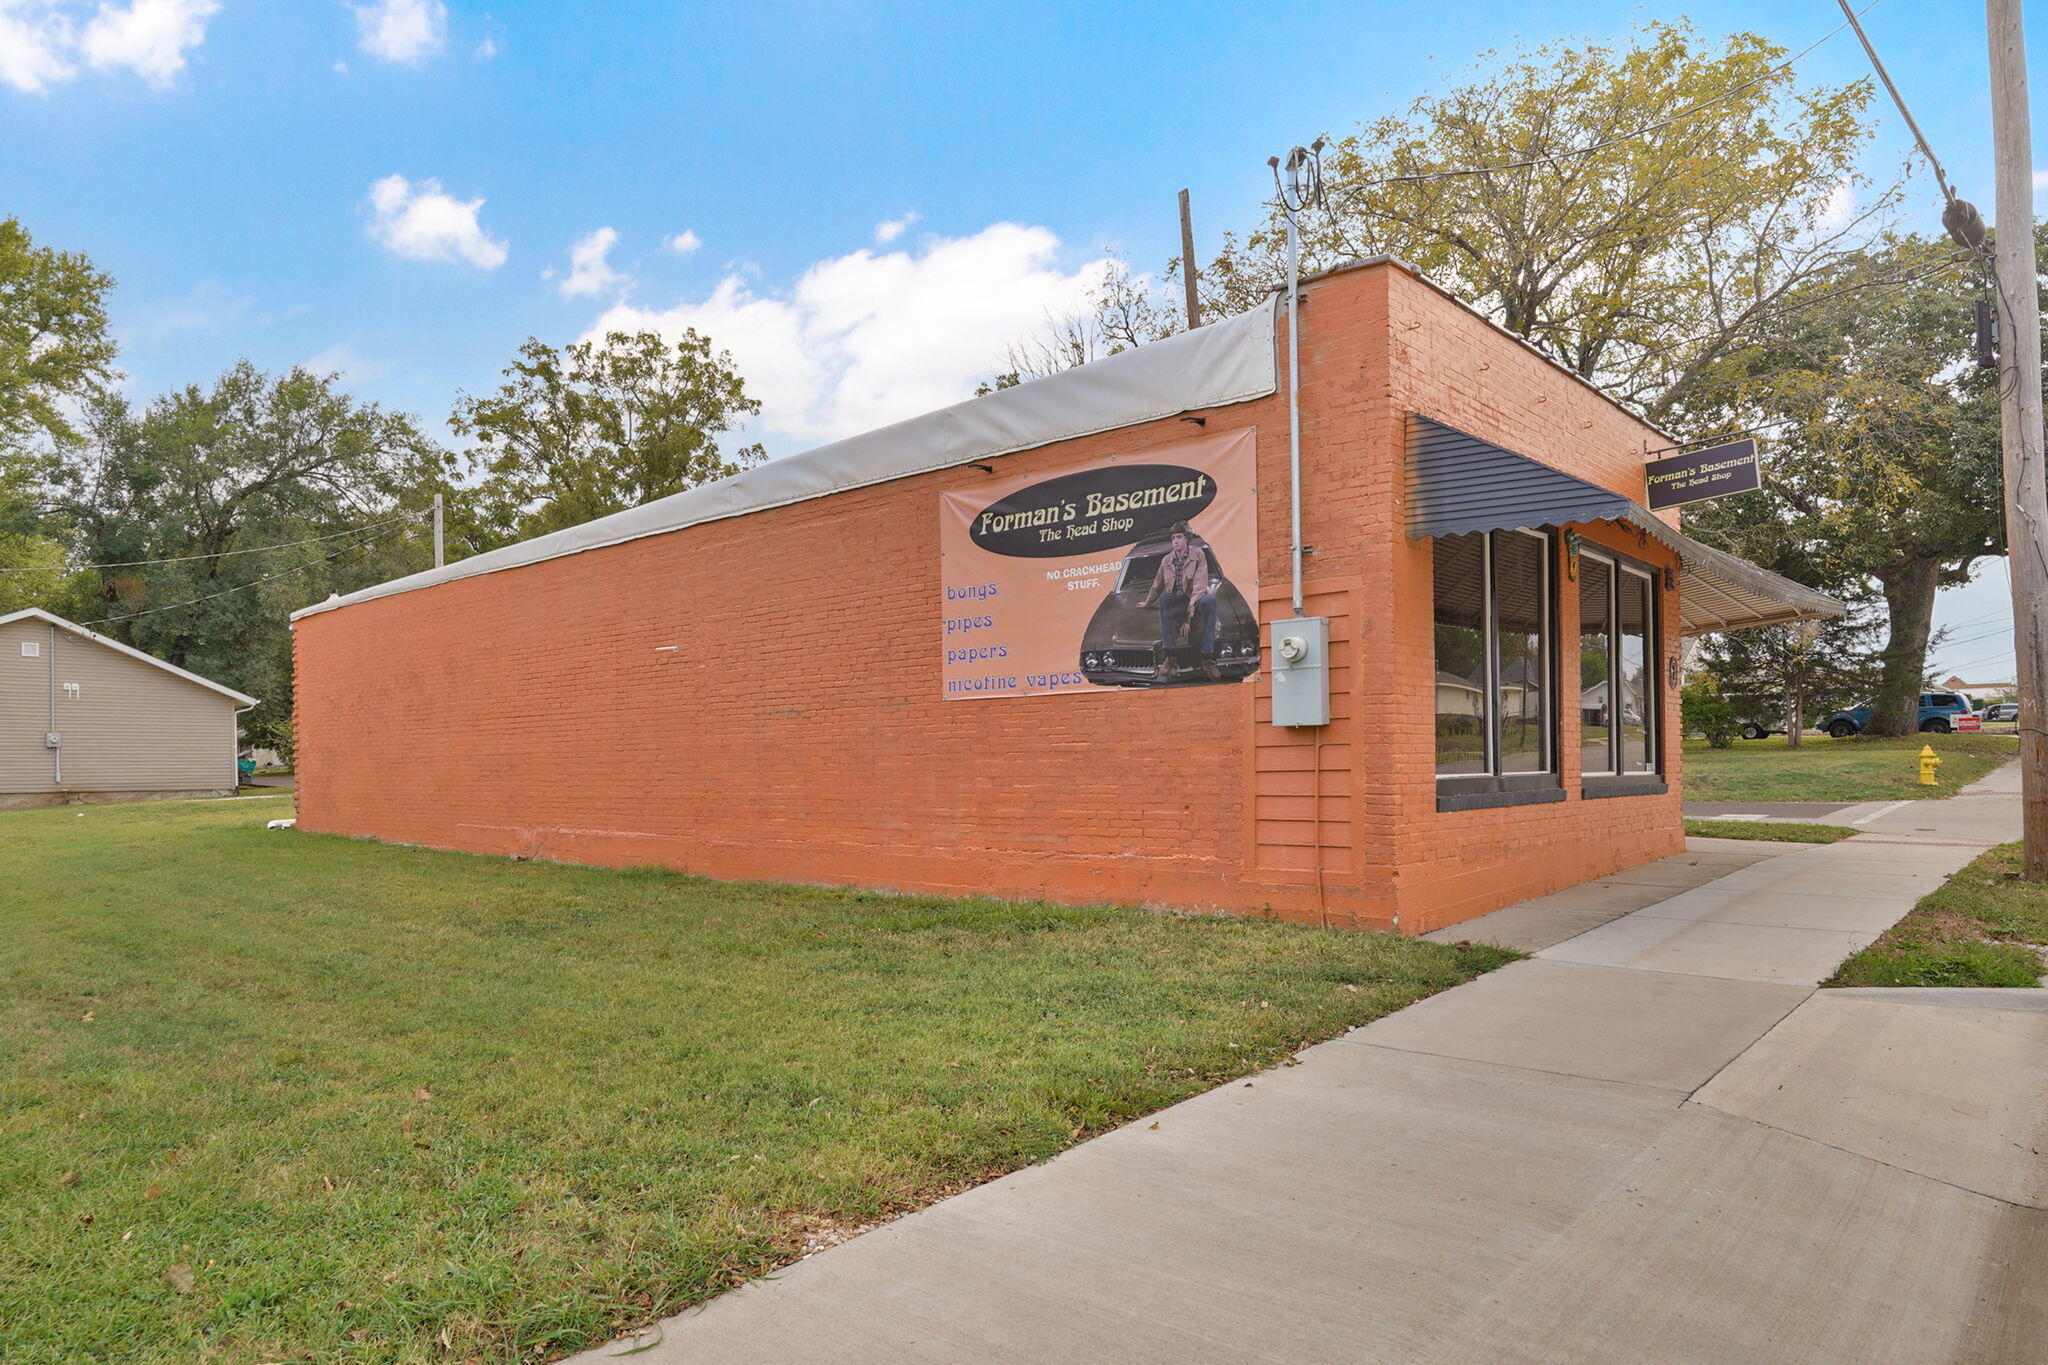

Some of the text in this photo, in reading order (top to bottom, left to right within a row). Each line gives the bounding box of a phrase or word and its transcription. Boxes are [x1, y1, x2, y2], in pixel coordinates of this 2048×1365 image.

[1648, 453, 1755, 486] Forman's Basement
[1671, 479, 1686, 490] The
[1712, 471, 1732, 481] Shop
[979, 473, 1207, 536] Forman's Basement
[1039, 528, 1062, 543] The
[1101, 517, 1134, 532] Shop
[1045, 561, 1122, 580] NO CRACKHEAD
[947, 583, 997, 600] bongs
[1067, 578, 1101, 591] STUFF.
[947, 615, 993, 634] pipes
[947, 645, 1008, 664] papers
[948, 671, 1082, 692] nicotine vapes
